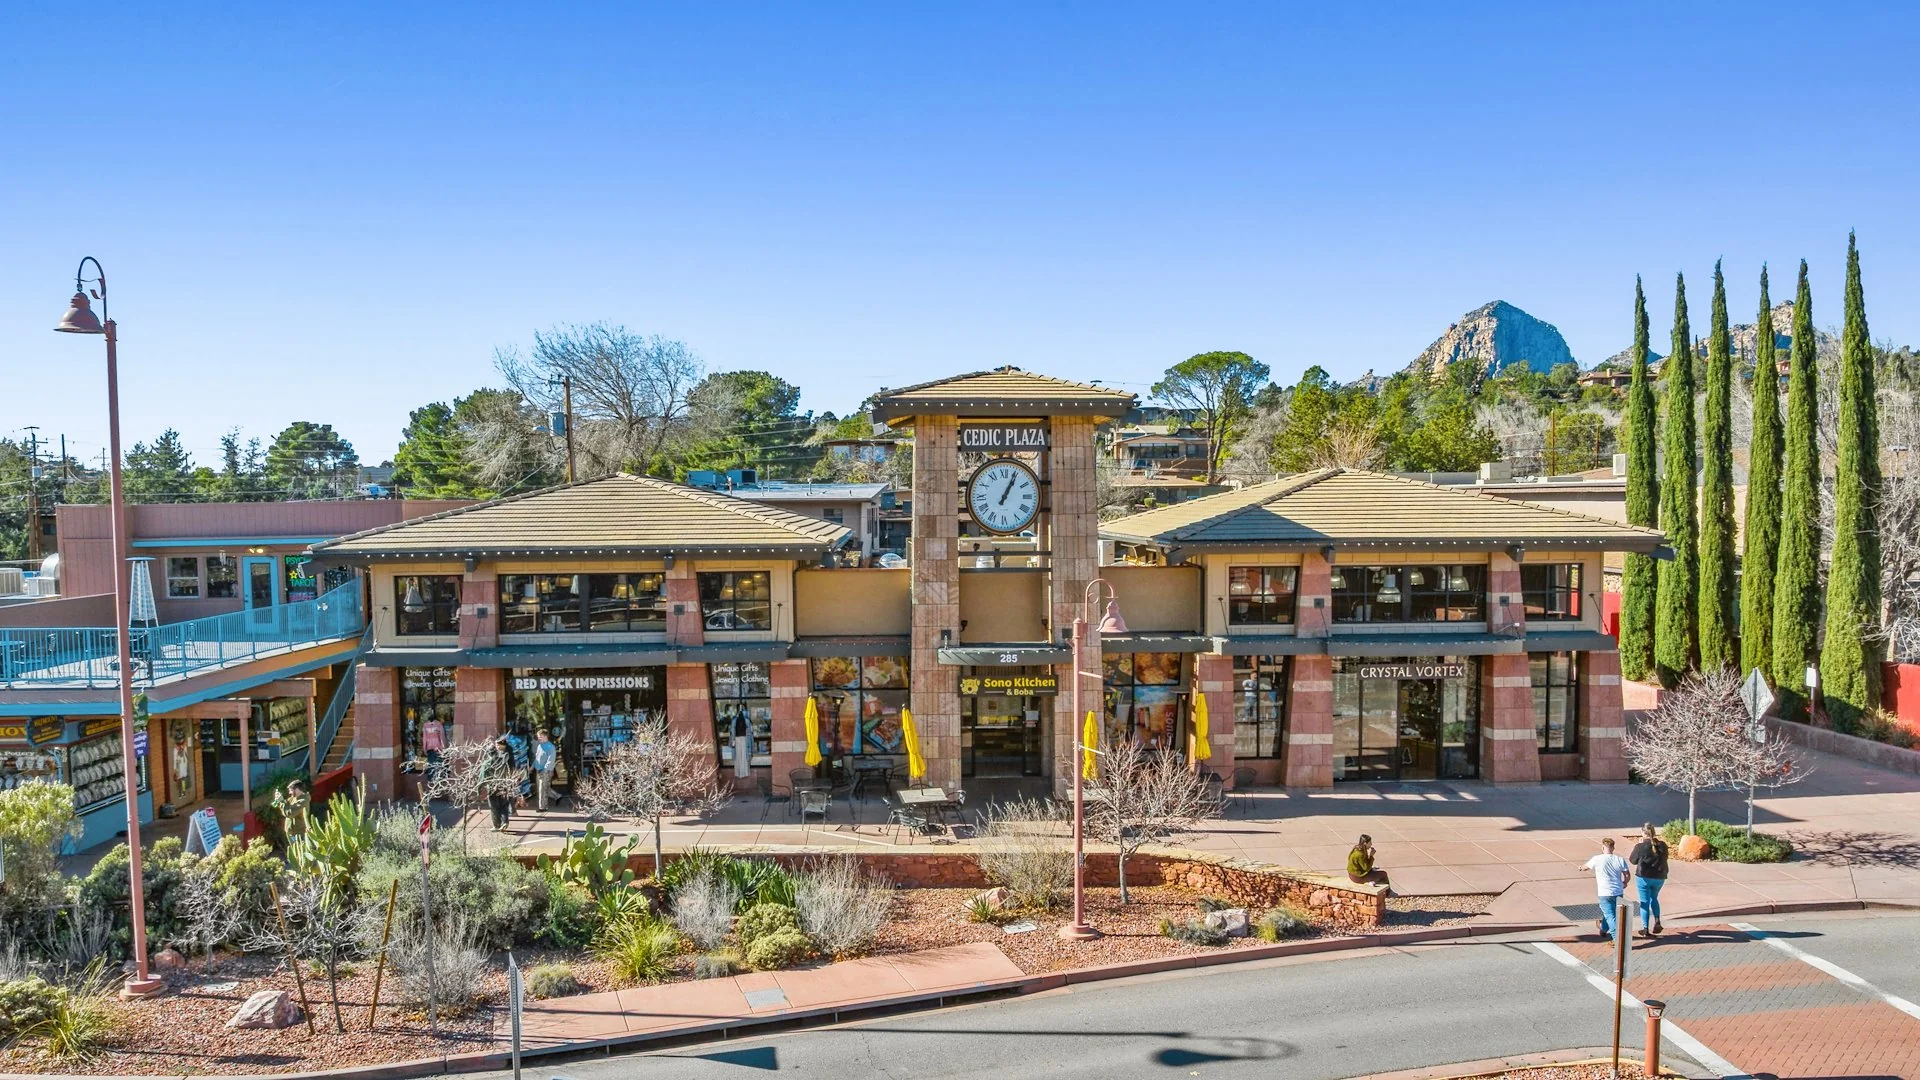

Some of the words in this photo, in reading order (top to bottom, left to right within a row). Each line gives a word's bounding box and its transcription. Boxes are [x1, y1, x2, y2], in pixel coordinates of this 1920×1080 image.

[963, 428, 1001, 446] CEDIC
[1005, 428, 1046, 446] PLAZA
[291, 579, 315, 587] TAROT
[1000, 654, 1018, 663] 285
[405, 669, 431, 680] Unique
[432, 667, 451, 677] Gifts
[713, 665, 740, 675] Unique
[741, 662, 759, 672] Gifts
[1360, 667, 1413, 678] CRYSTAL
[1416, 665, 1463, 677] VORTEX
[433, 679, 457, 688] Clothin
[515, 678, 537, 690] RED
[540, 678, 574, 690] ROCK
[575, 677, 650, 689] IMPRESSIONS
[741, 673, 769, 685] Clothing
[984, 678, 1012, 688] Sono
[1014, 677, 1056, 687] Kitchen
